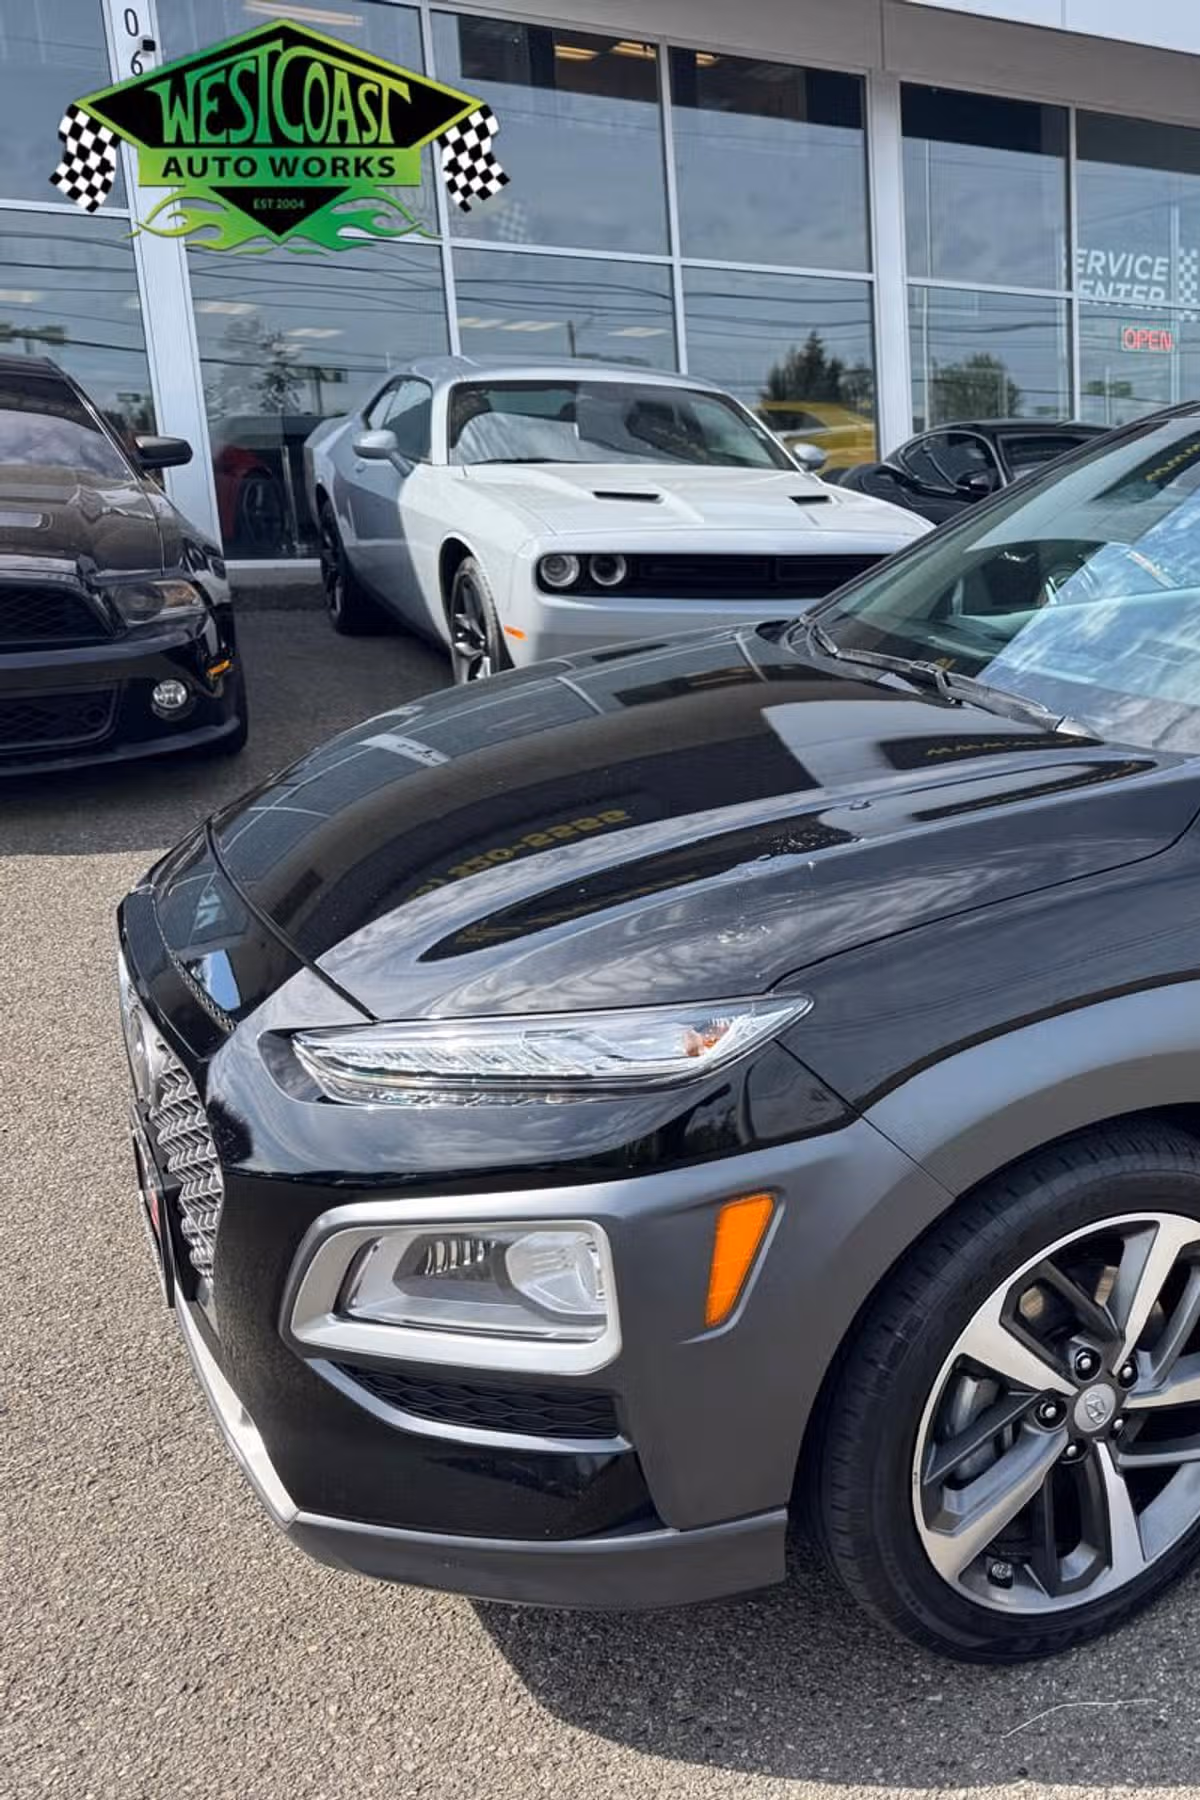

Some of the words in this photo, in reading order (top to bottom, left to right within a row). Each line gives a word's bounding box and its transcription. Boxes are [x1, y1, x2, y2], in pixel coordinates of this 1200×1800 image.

[1074, 248, 1170, 282] ERVICE
[1078, 280, 1166, 311] ENTER
[1123, 329, 1173, 350] OPEN
